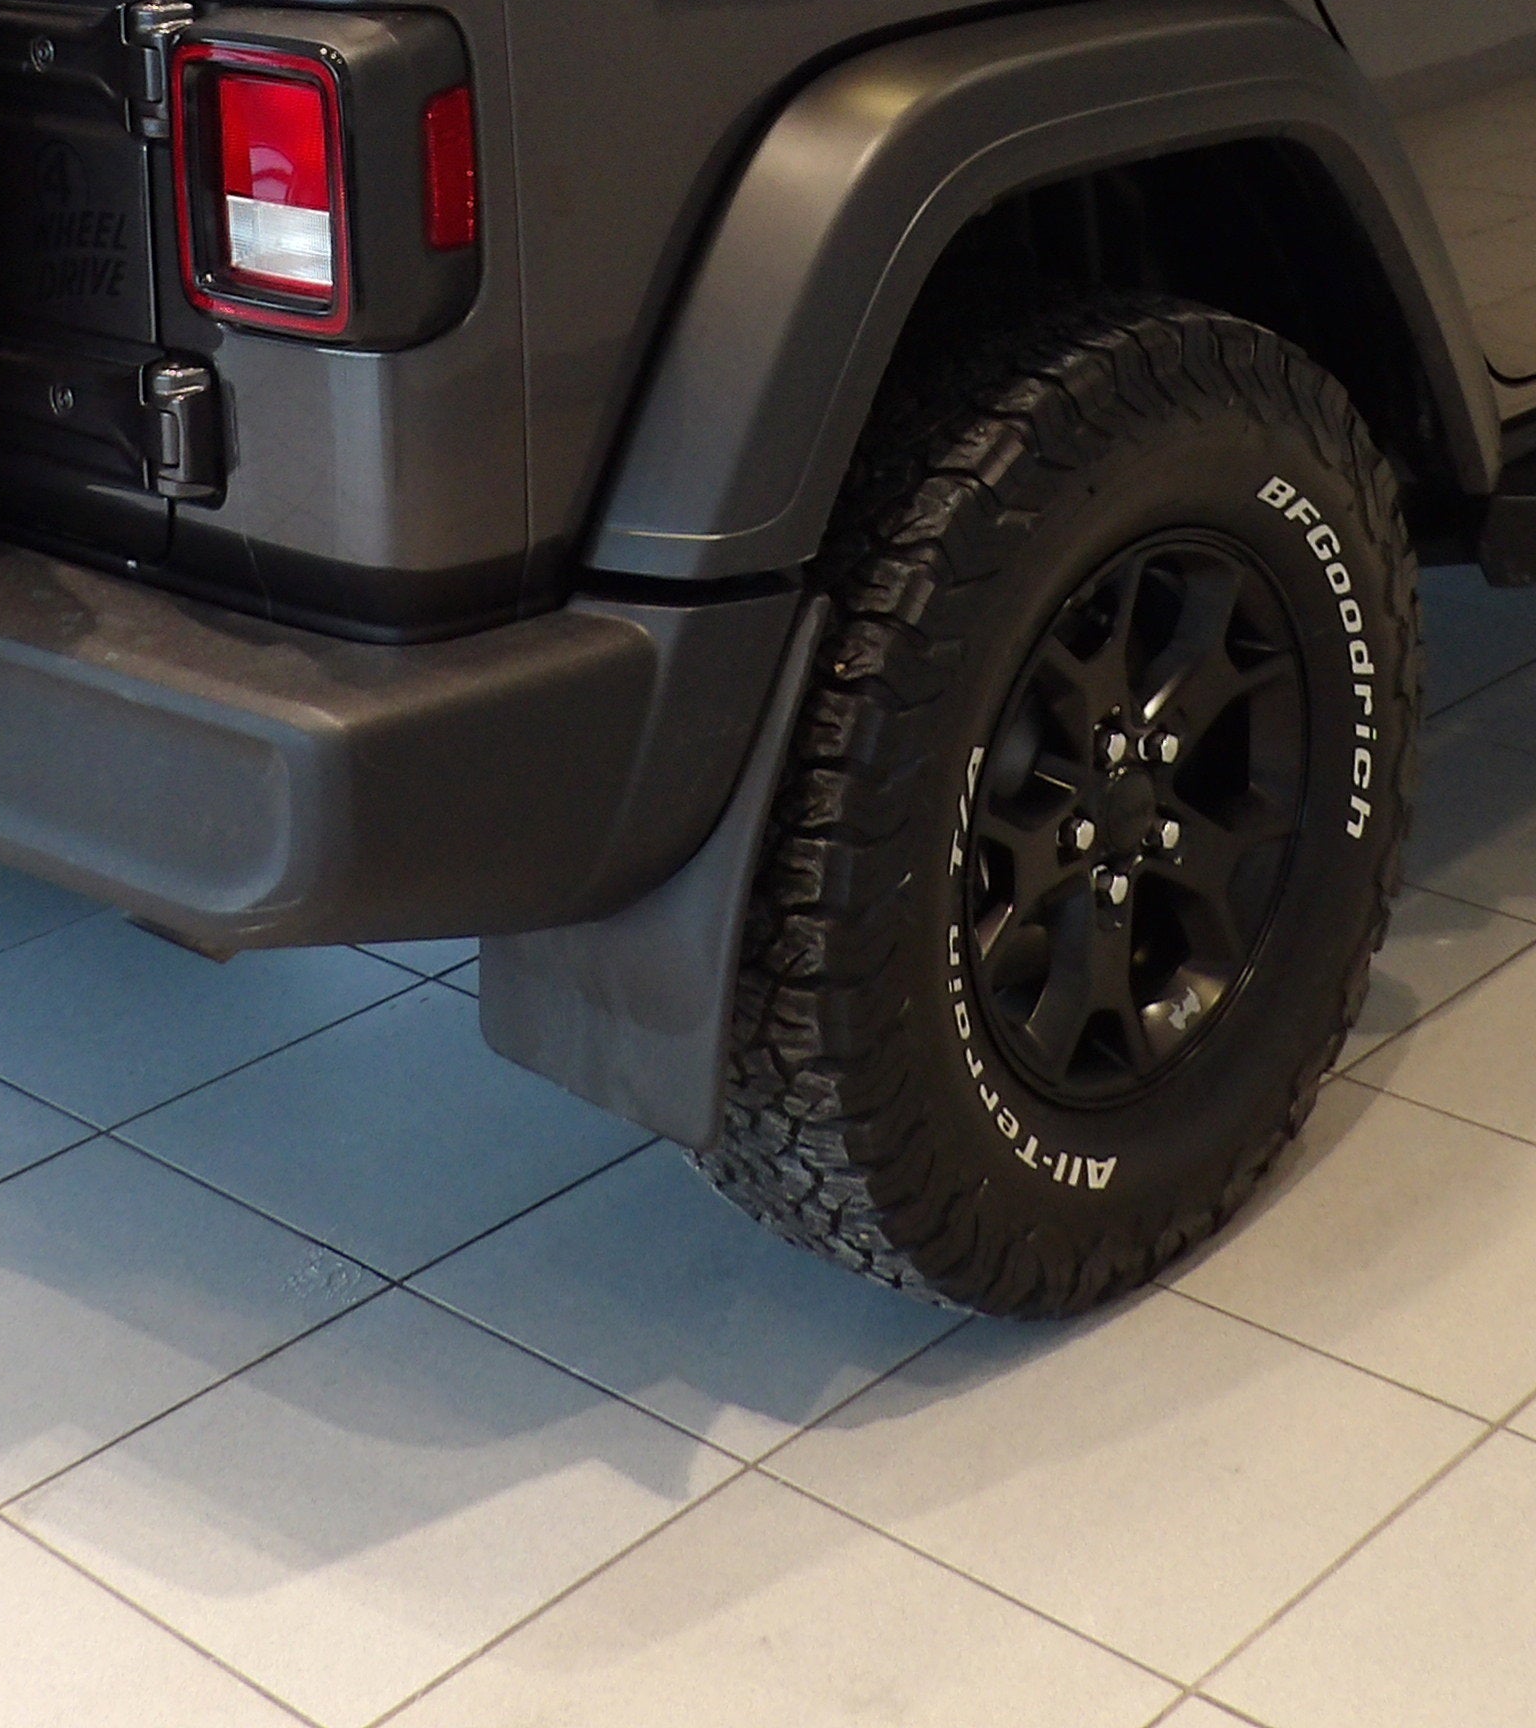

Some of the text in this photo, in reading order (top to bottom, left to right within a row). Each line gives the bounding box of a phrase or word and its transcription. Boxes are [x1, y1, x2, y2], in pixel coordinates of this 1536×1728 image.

[36, 257, 127, 302] DRIVE
[1257, 476, 1377, 839] BFGoodrich
[948, 746, 1117, 1190] All-Terrain T/A
